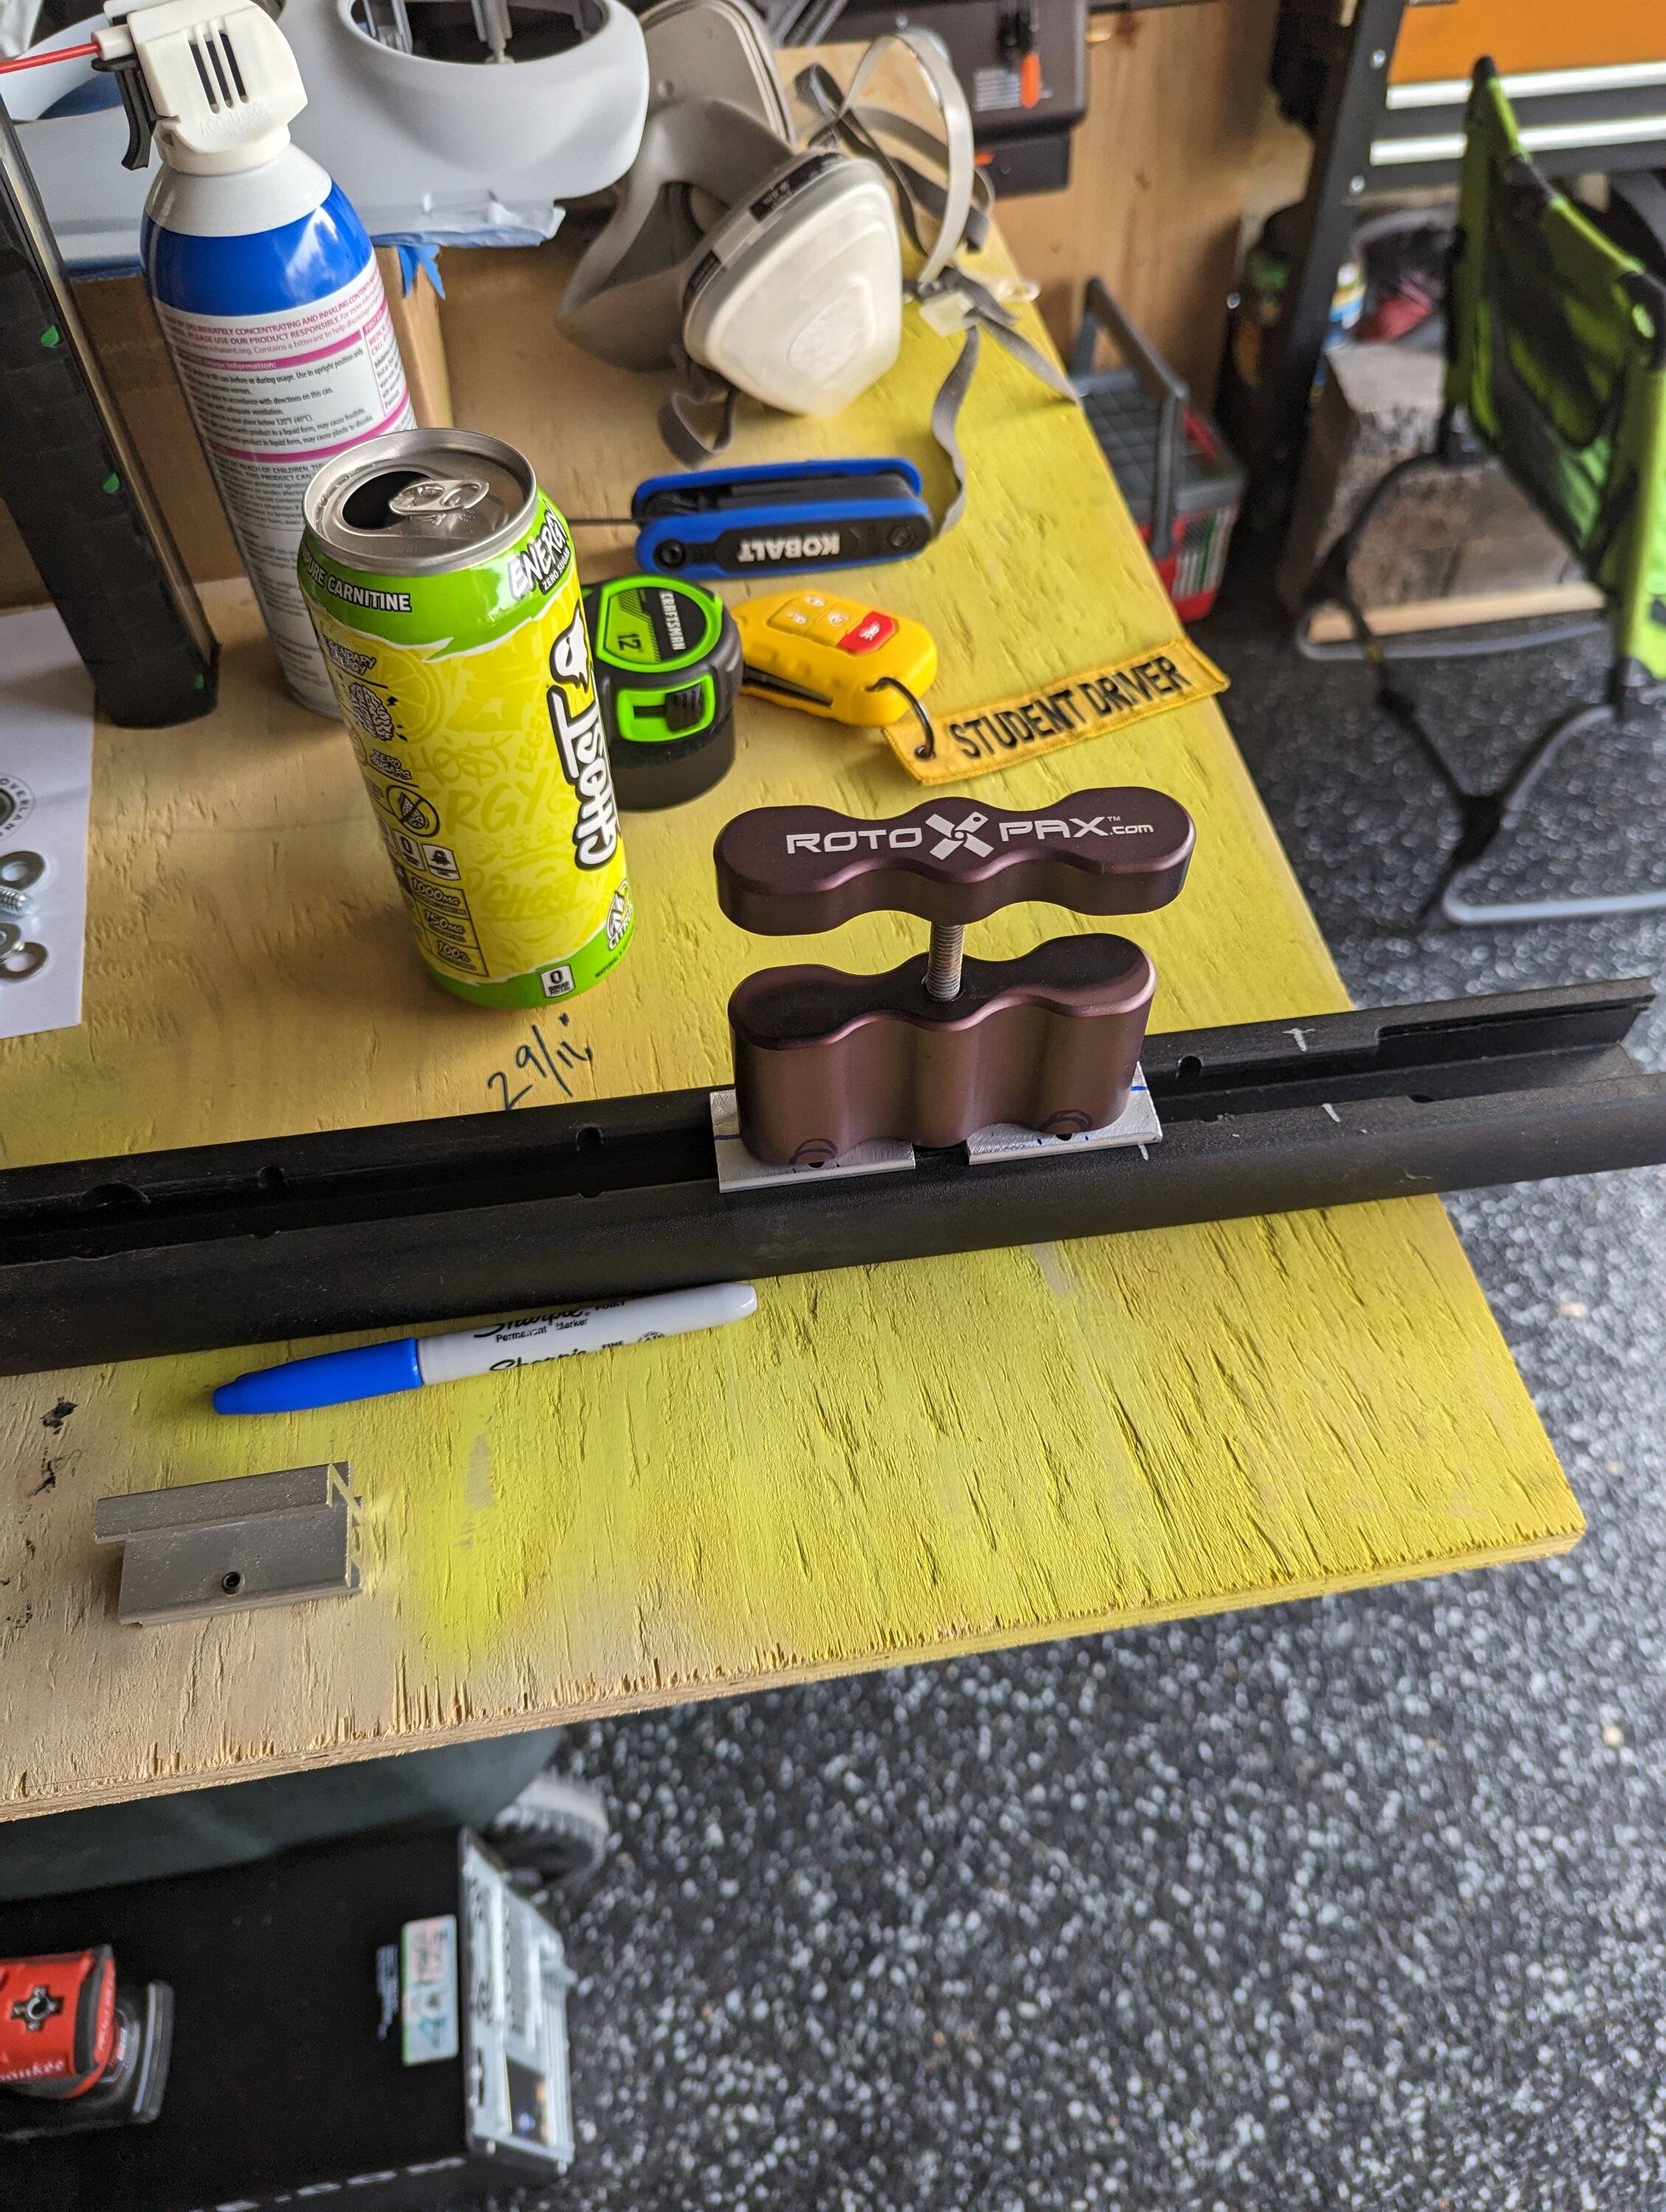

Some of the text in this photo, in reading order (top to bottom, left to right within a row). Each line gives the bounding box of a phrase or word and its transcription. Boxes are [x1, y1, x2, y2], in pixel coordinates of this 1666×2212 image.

[235, 319, 302, 335] CONCENTRATING
[302, 315, 319, 326] AND
[319, 299, 350, 320] INHALING
[249, 333, 289, 345] PRODUCT
[290, 317, 340, 341] RESPONSIBLY.
[254, 344, 288, 355] Contains
[294, 335, 324, 349] bitterant
[332, 324, 347, 336] help
[256, 376, 277, 385] during
[296, 371, 307, 379] Use
[314, 363, 334, 375] upright
[274, 395, 302, 406] directions
[310, 389, 322, 399] this
[737, 529, 841, 563] KOBALT
[327, 574, 412, 613] CARNITINE
[541, 569, 560, 592] ZERO
[658, 589, 687, 650] CRAFTSMAN
[948, 655, 1193, 759] STUDENT DRIVER
[785, 827, 923, 855] ROTO
[549, 970, 563, 984] 0
[496, 1317, 588, 1343] Permanent Marker
